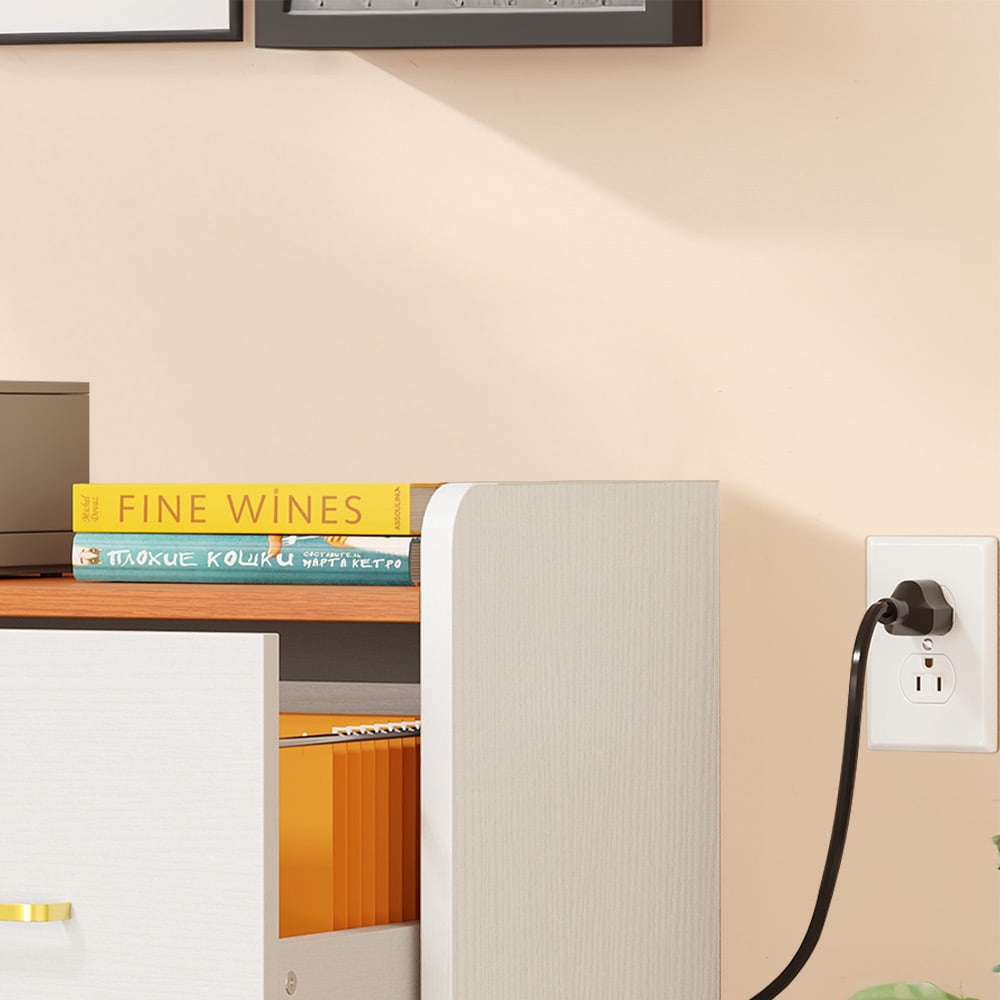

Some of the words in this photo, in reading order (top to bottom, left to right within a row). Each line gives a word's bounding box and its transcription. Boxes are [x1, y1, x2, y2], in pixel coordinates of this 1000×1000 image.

[119, 494, 206, 523] FINE
[107, 549, 198, 567] ПЛОХИЕ
[207, 549, 294, 568] КОШКИ
[352, 558, 402, 569] КЕТРО
